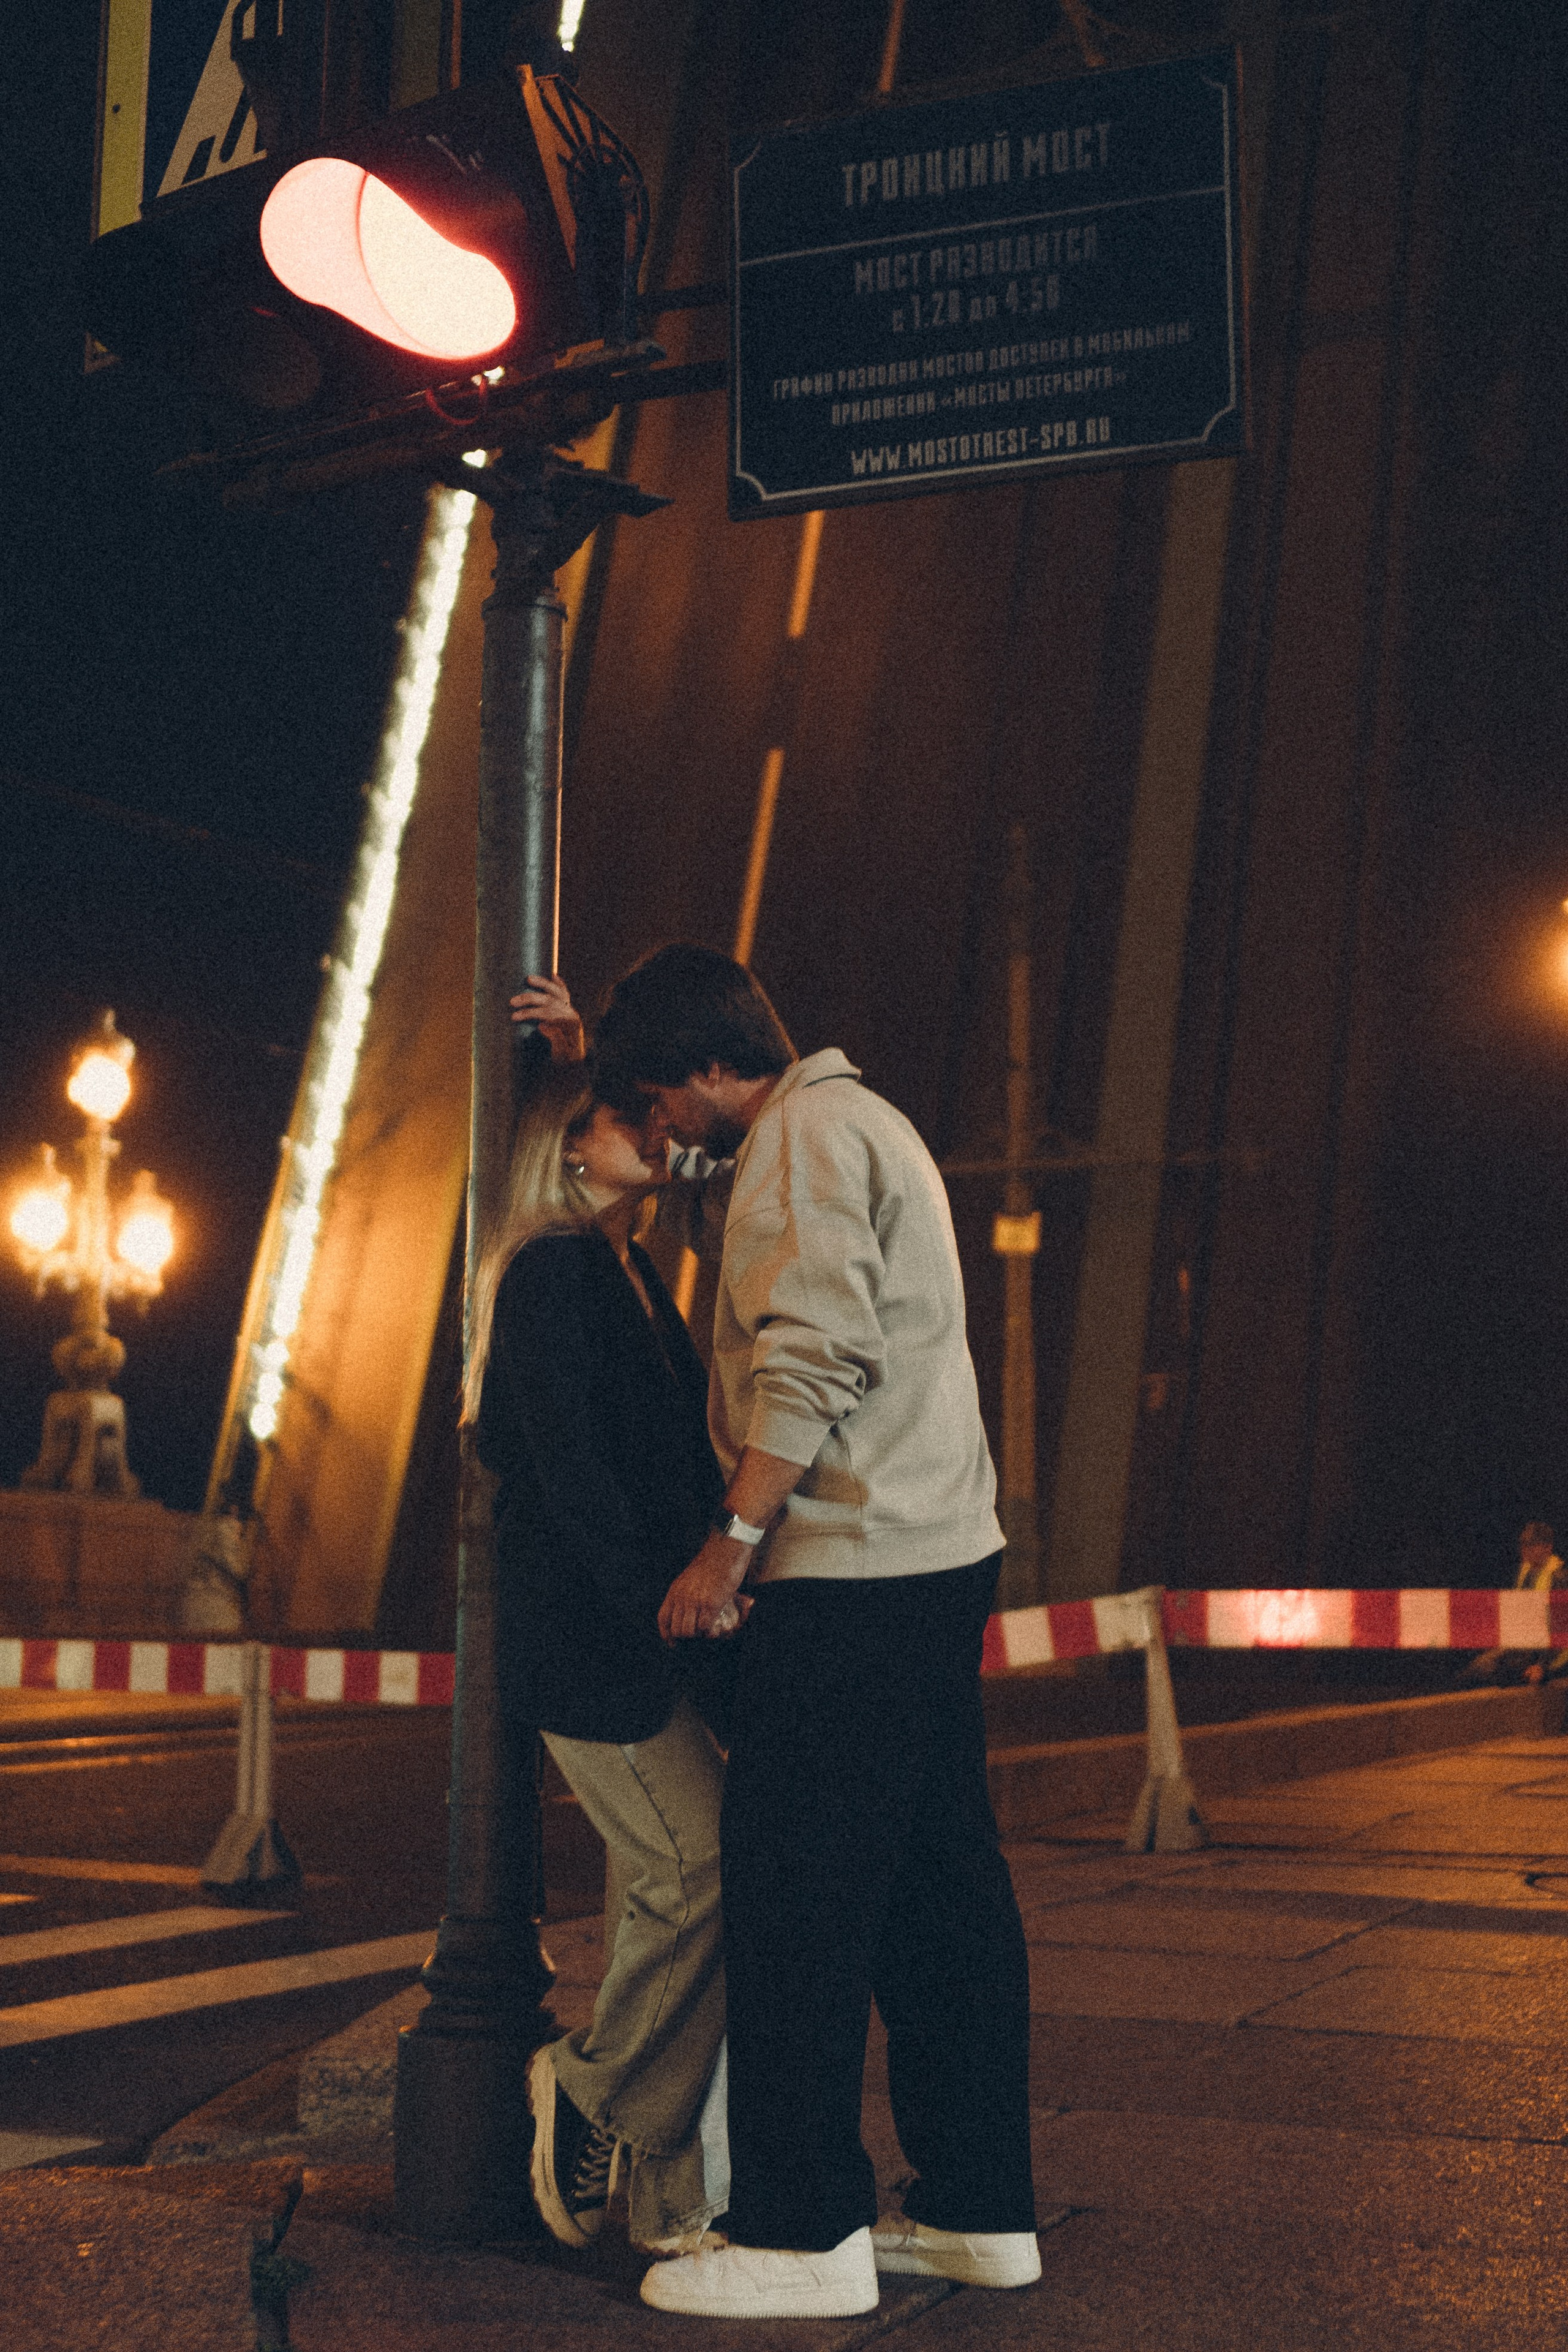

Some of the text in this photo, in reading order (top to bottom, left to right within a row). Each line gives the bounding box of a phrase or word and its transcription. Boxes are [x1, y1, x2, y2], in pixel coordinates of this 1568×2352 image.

[842, 120, 1112, 206] ТРОИЦКИЙ МОСТ
[854, 222, 1097, 294] МОСТ РАЗВОДИТСЯ
[774, 372, 833, 400] ГРАФИК
[851, 416, 1110, 475] WWW.MOSTOTREST-SPB.RU
